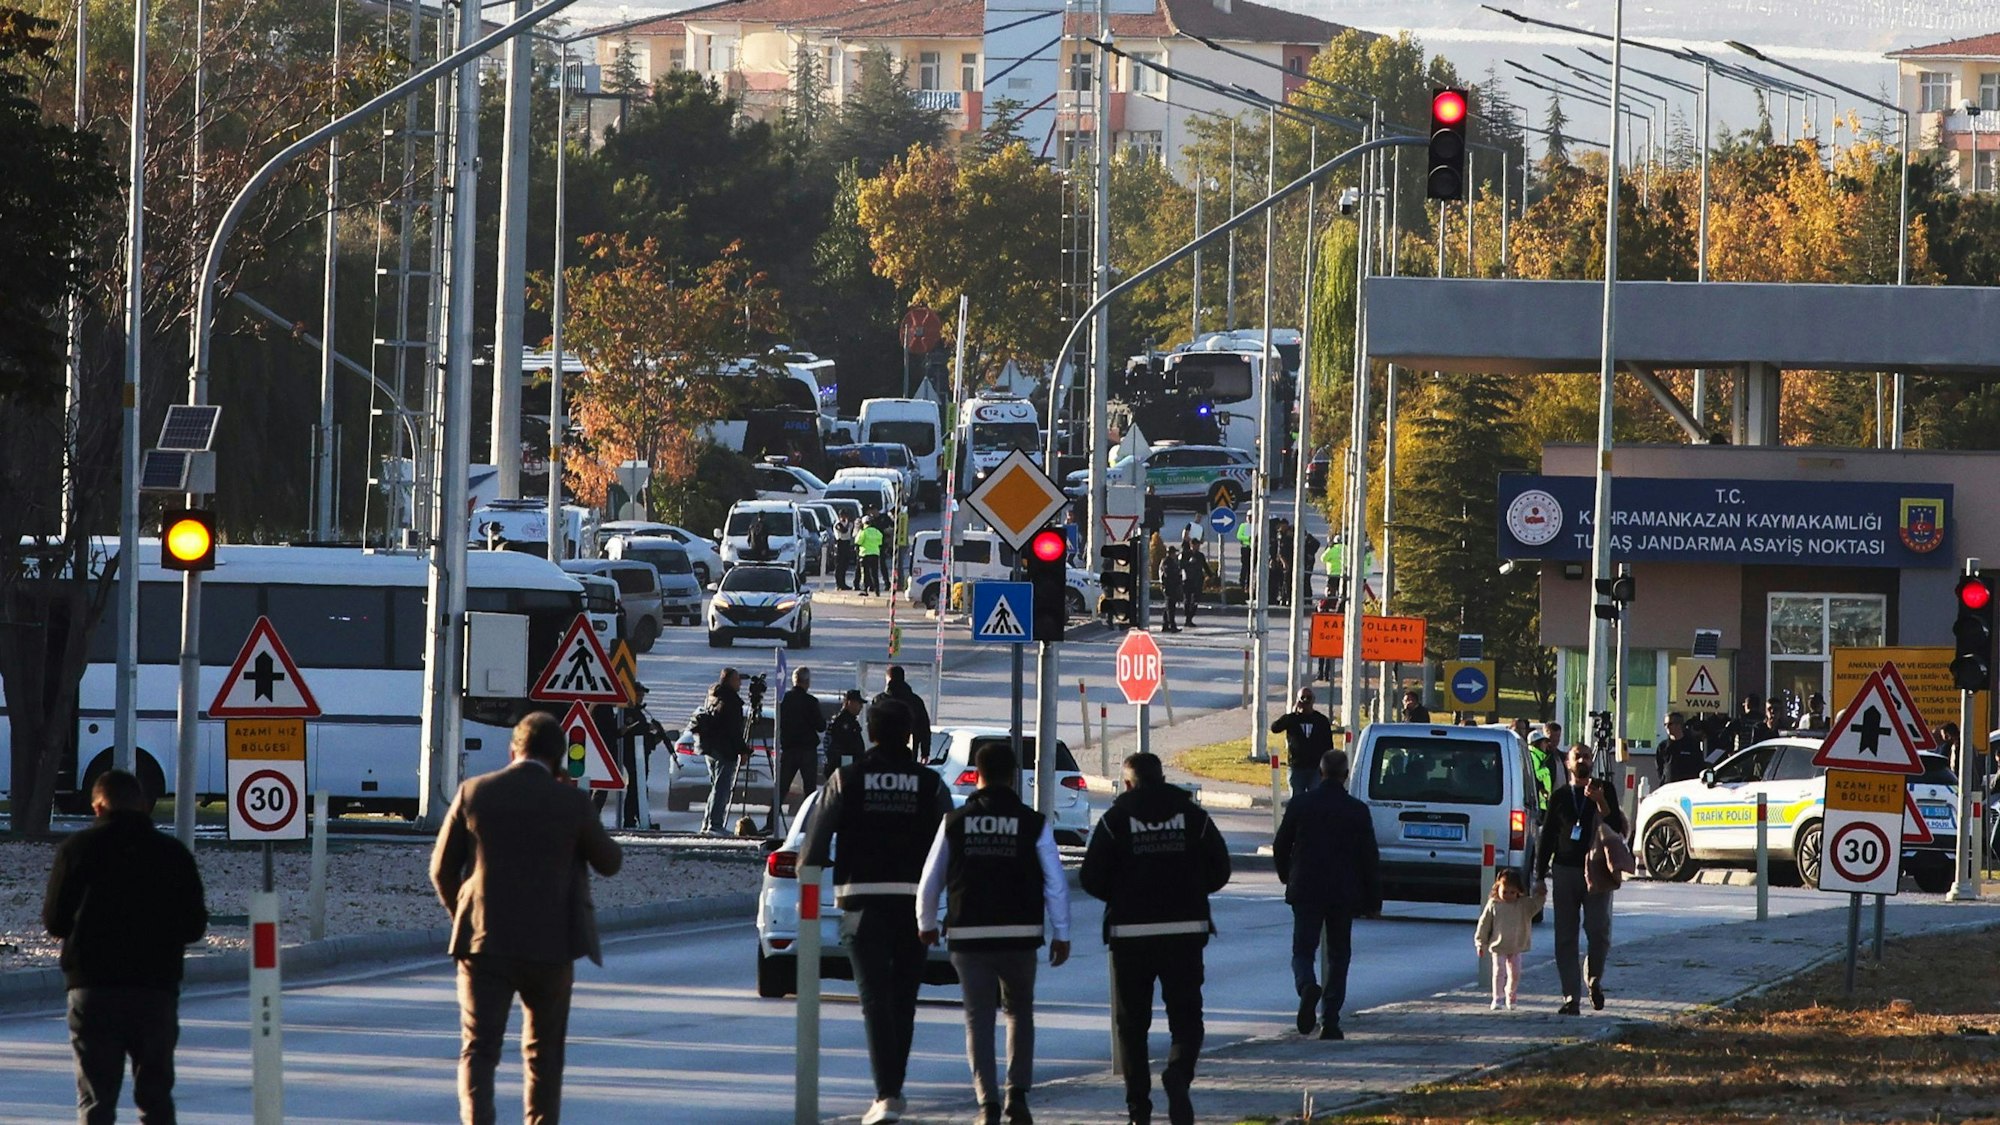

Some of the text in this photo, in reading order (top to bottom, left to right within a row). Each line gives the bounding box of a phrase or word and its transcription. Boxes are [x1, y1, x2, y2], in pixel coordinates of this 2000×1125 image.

[1715, 488, 1746, 504] T.C.
[1578, 510, 1741, 528] KHRAMANKAZAN
[1746, 512, 1882, 531] KAYMAKAMLIĞI
[1574, 534, 1885, 557] TUAŞ JANDARMA ASAYİŞ NOKTASI
[1323, 621, 1413, 632] KAOLLARI
[1120, 654, 1157, 681] DUR
[1685, 698, 1721, 709] YAVAŞ
[864, 772, 919, 792] KOM
[250, 786, 284, 811] 30
[1696, 808, 1752, 821] TRAFİK POLİSİ
[964, 816, 1019, 835] KOM
[1843, 838, 1878, 865] 30
